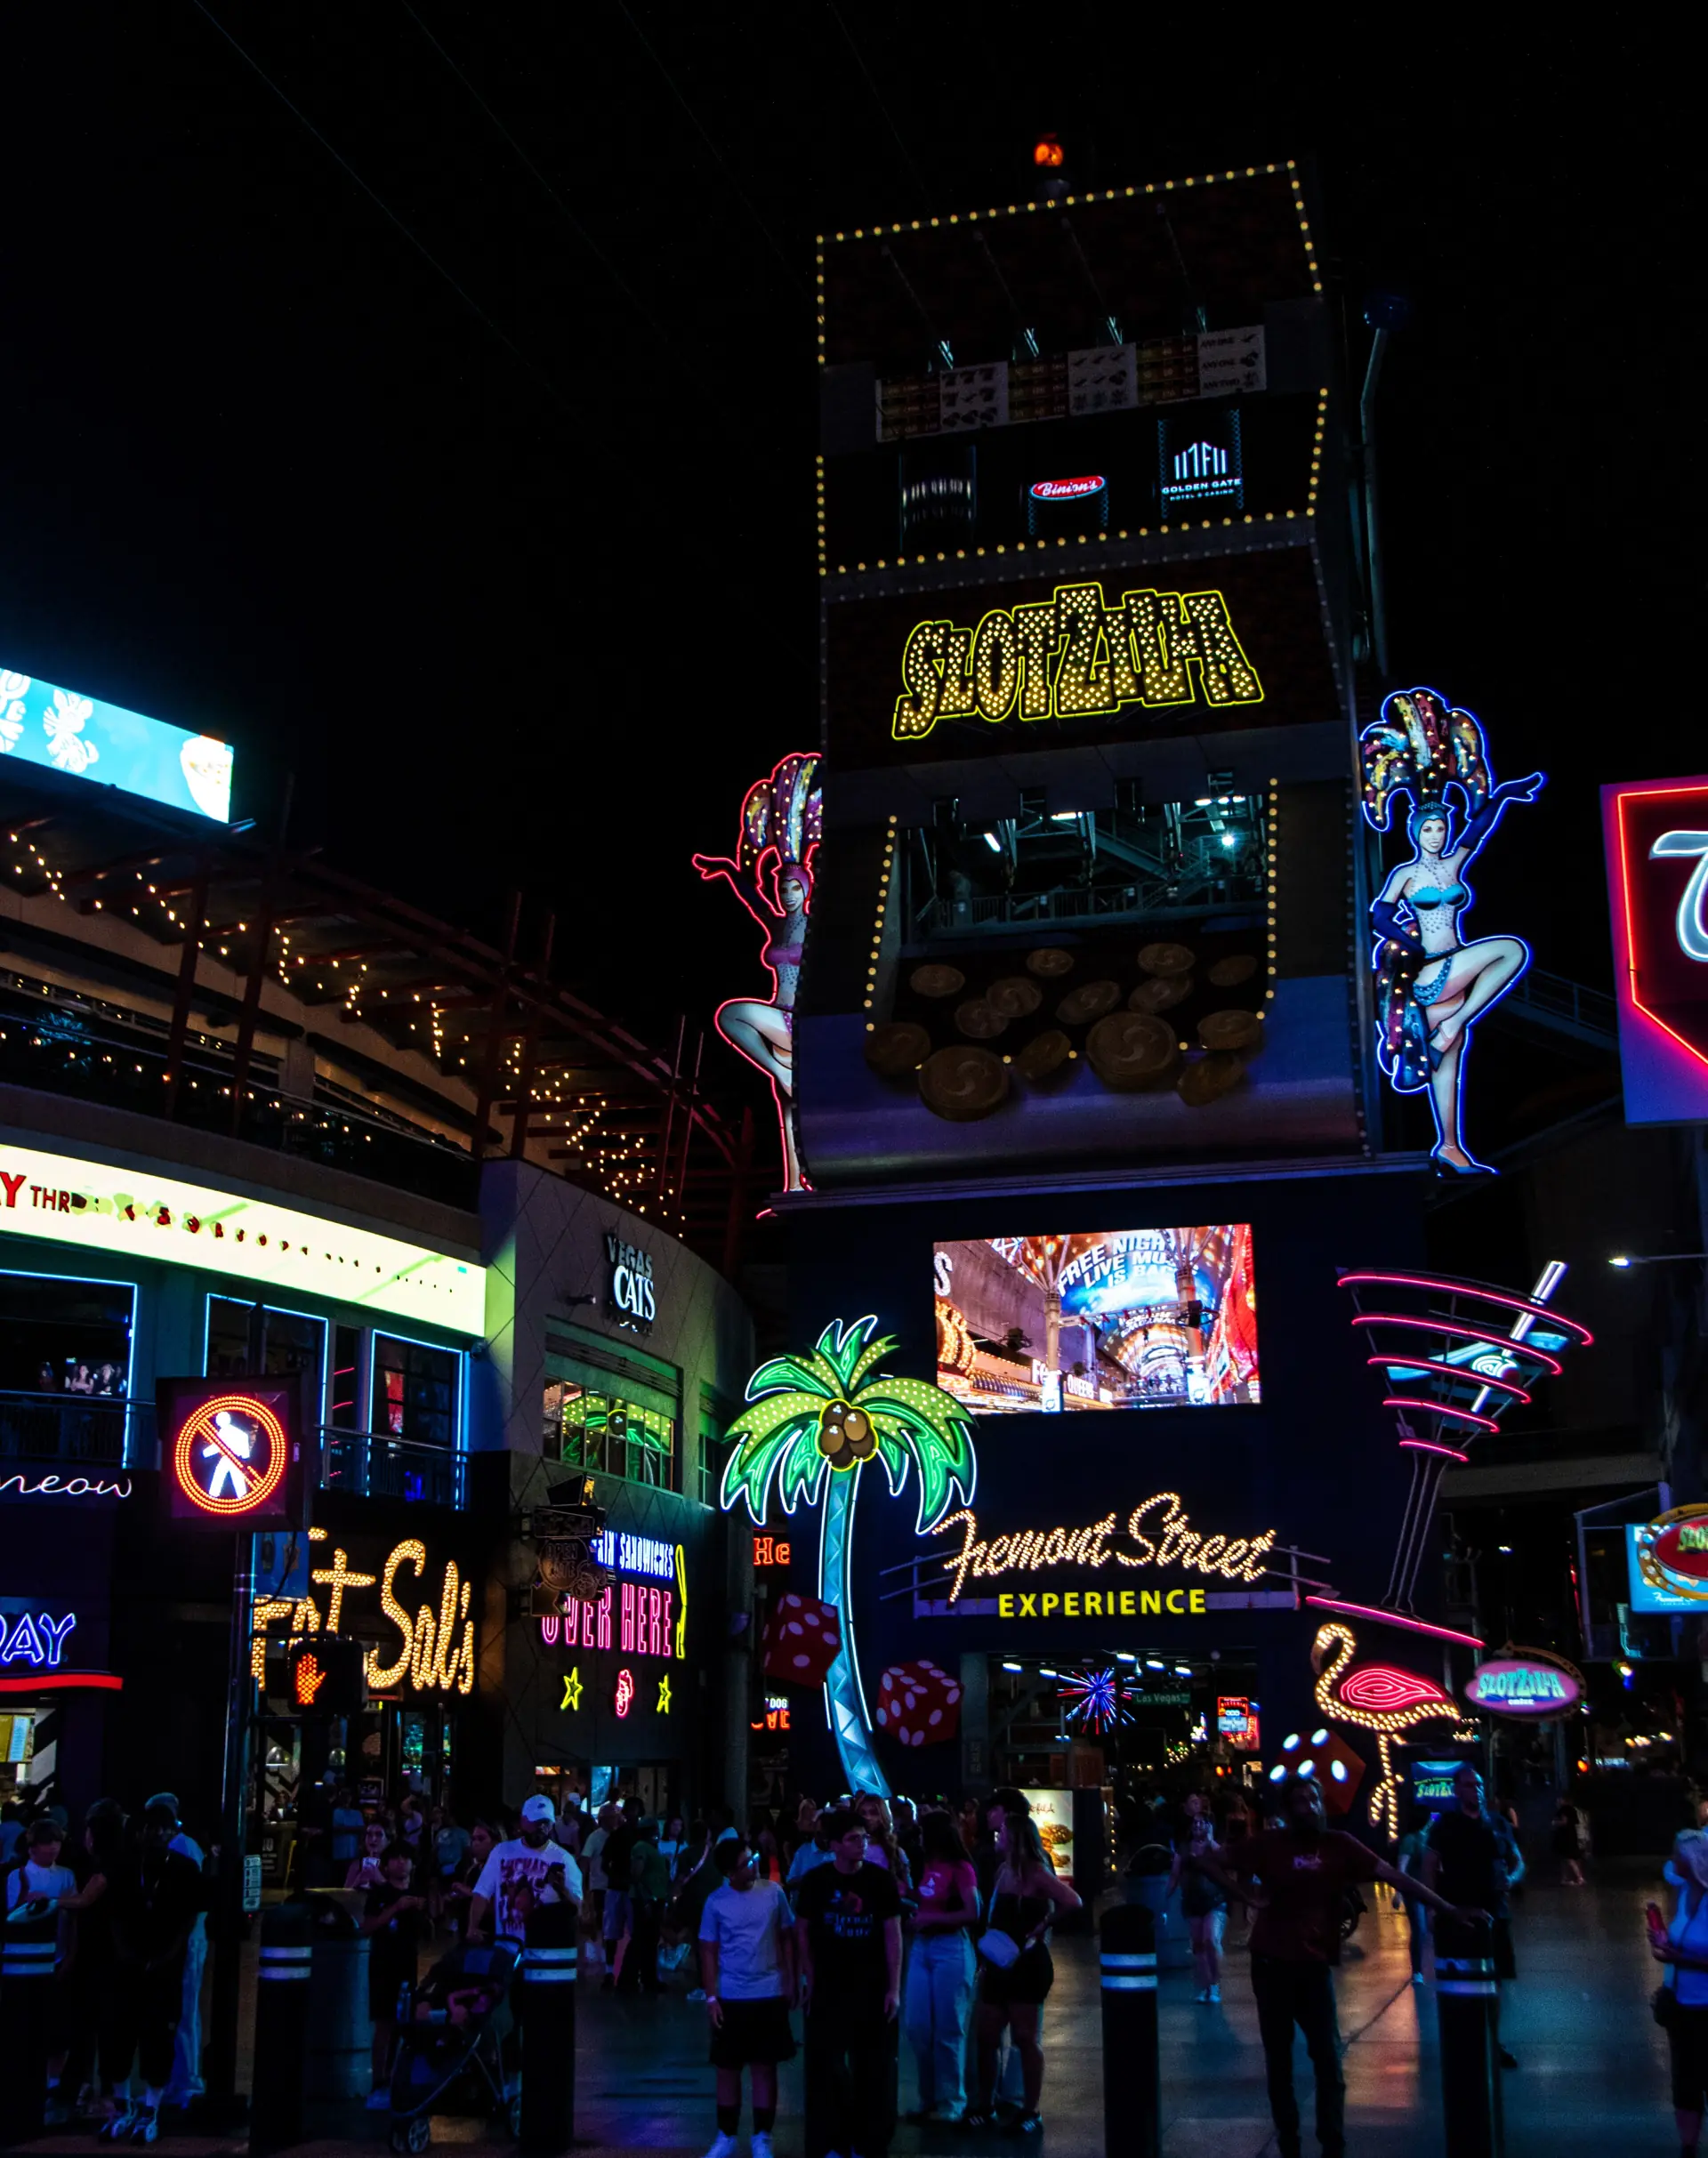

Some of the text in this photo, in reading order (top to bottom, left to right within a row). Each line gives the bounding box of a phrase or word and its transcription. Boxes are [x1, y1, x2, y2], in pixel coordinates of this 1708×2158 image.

[1037, 479, 1099, 496] Binion's
[1161, 478, 1242, 495] GOLDEN GATE
[1170, 492, 1195, 501] HOTEL
[1204, 487, 1235, 496] CASINO
[892, 582, 1264, 739] SLOTZILLA
[0, 1172, 27, 1209] Y
[605, 1235, 654, 1280] VEGAS
[1057, 1244, 1106, 1297] FREE
[1084, 1253, 1125, 1289] LIVE
[1108, 1268, 1127, 1287] IS
[618, 1532, 674, 1580] SANDWICHES
[931, 1492, 1277, 1606] Fremont Street
[367, 1538, 474, 1695] Sal's
[621, 1582, 673, 1656] HERE
[997, 1588, 1207, 1620] EXPERIENCE
[1136, 1693, 1152, 1703] Las
[1154, 1693, 1181, 1705] Vegas
[1476, 1668, 1567, 1699] SLOTZILLA
